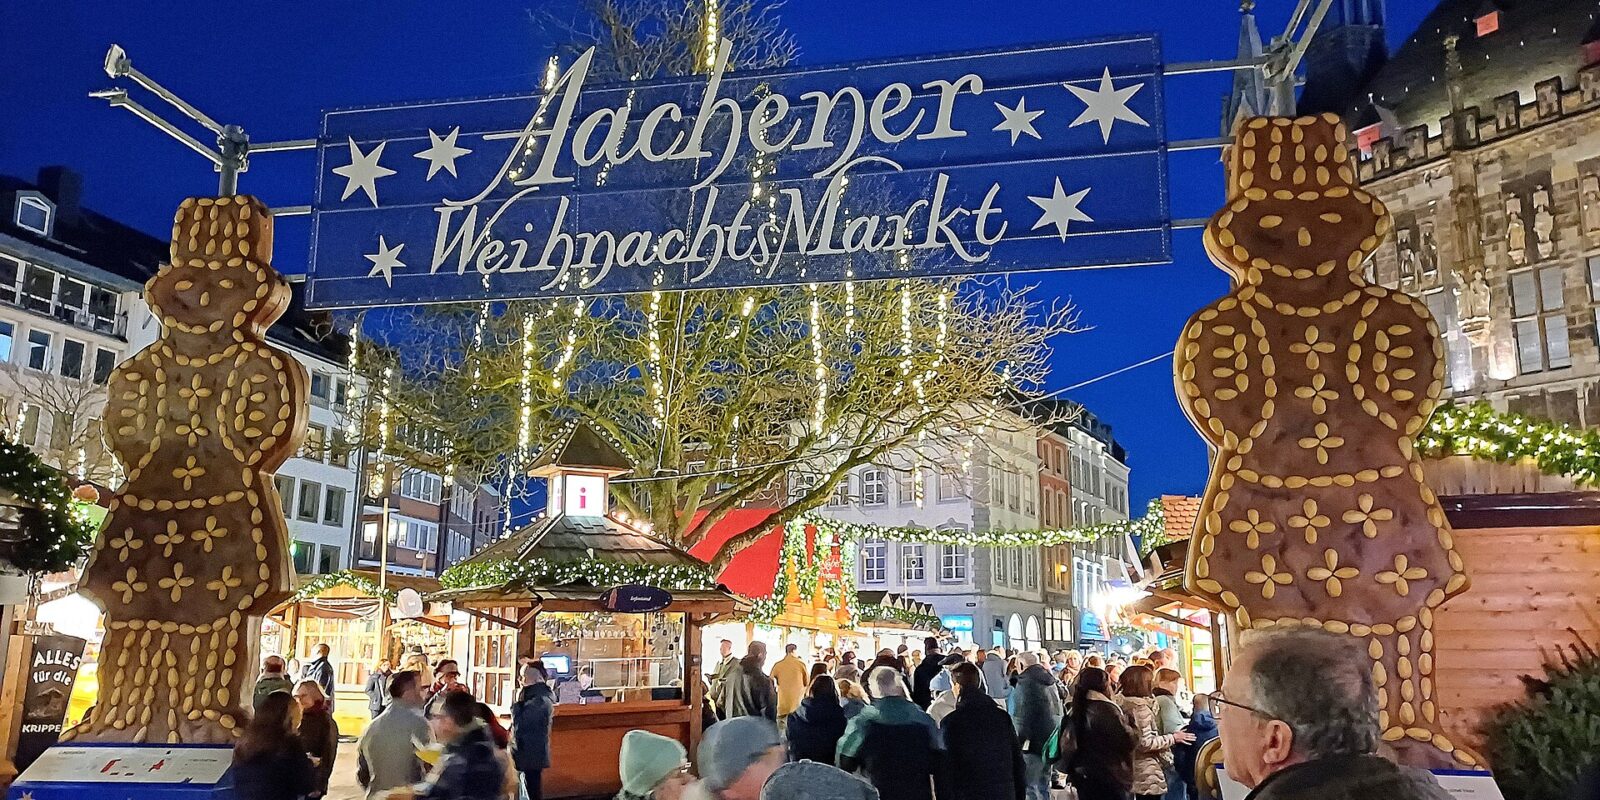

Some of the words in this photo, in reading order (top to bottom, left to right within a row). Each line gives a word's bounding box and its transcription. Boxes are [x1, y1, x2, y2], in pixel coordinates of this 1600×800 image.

[442, 38, 983, 206] Aachener
[34, 650, 80, 670] ALLES
[33, 670, 50, 683] für
[53, 671, 71, 686] die
[22, 724, 61, 733] KRIPPE
